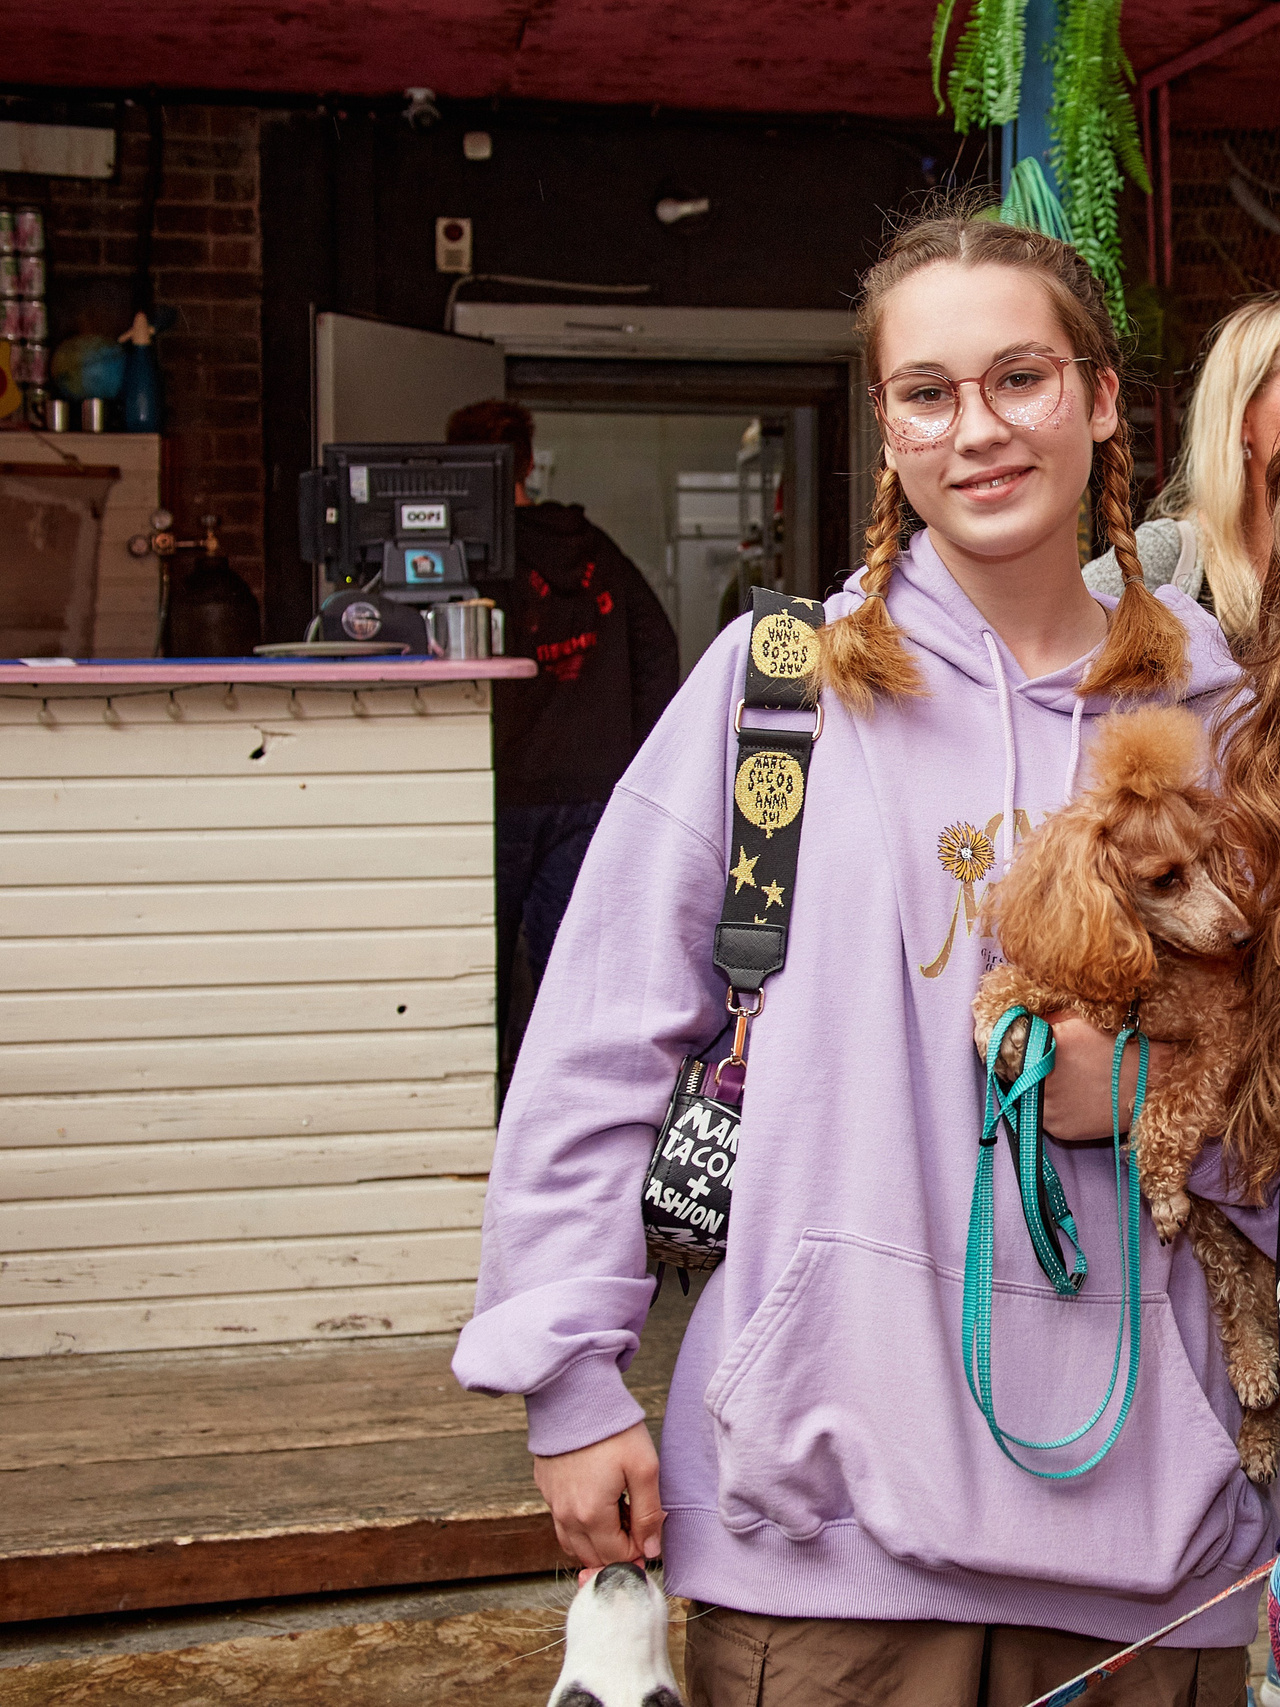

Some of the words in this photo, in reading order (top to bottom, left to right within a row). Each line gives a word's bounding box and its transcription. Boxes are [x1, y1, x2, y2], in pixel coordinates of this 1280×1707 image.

[775, 617, 796, 630] SUI
[767, 626, 800, 645] ANNA
[754, 755, 786, 770] MARC
[755, 791, 788, 810] ANNA
[759, 810, 780, 826] SUI
[644, 1177, 725, 1234] ASHION
